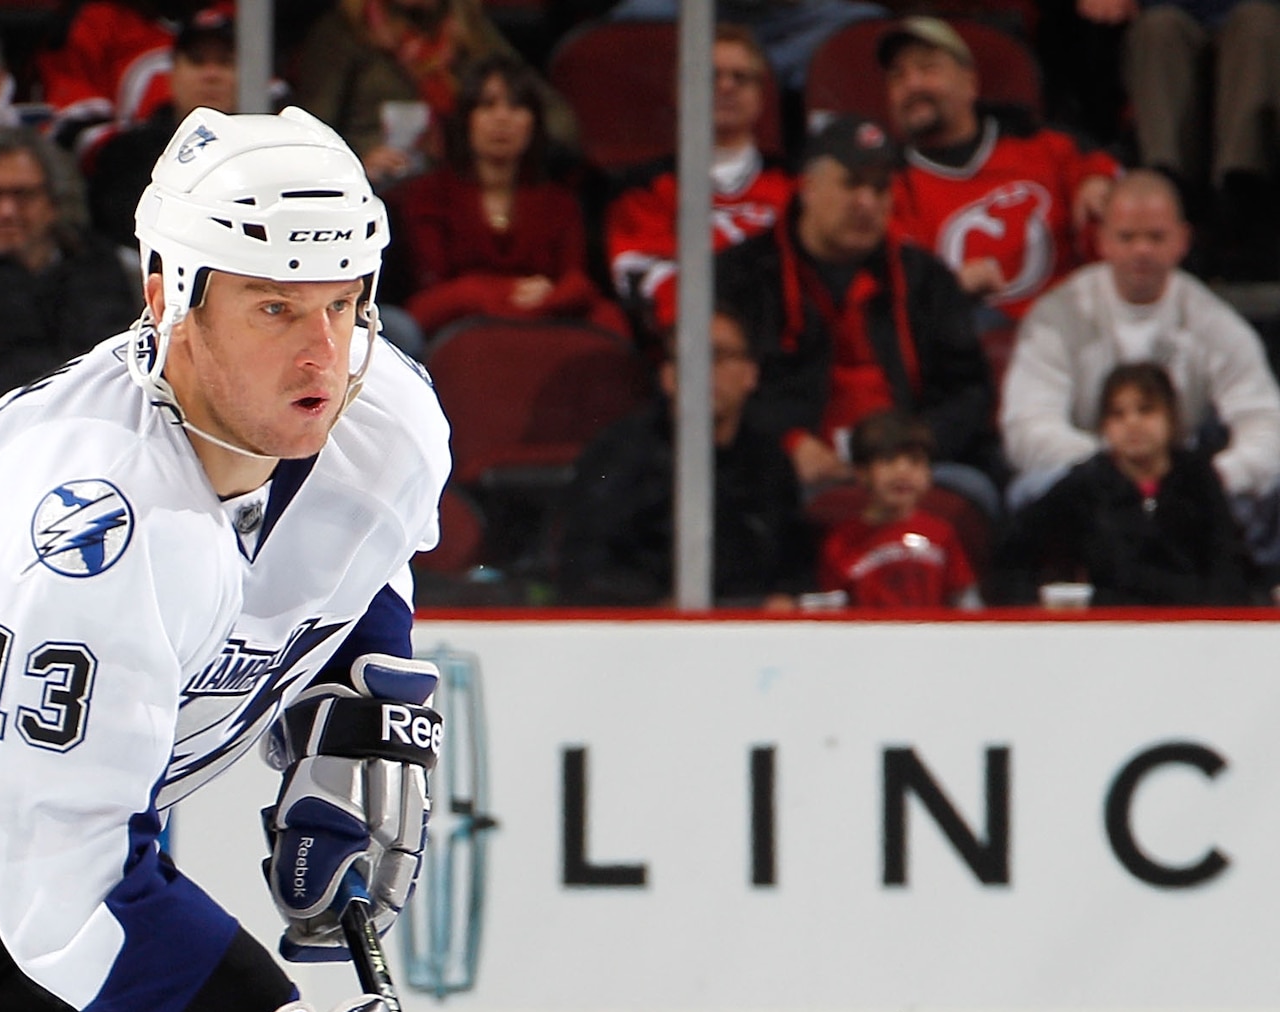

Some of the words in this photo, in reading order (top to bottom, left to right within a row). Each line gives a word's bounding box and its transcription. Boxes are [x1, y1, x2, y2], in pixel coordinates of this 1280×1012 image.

[288, 229, 353, 242] CCM
[559, 738, 1232, 890] LINC
[294, 836, 315, 898] Reebok
